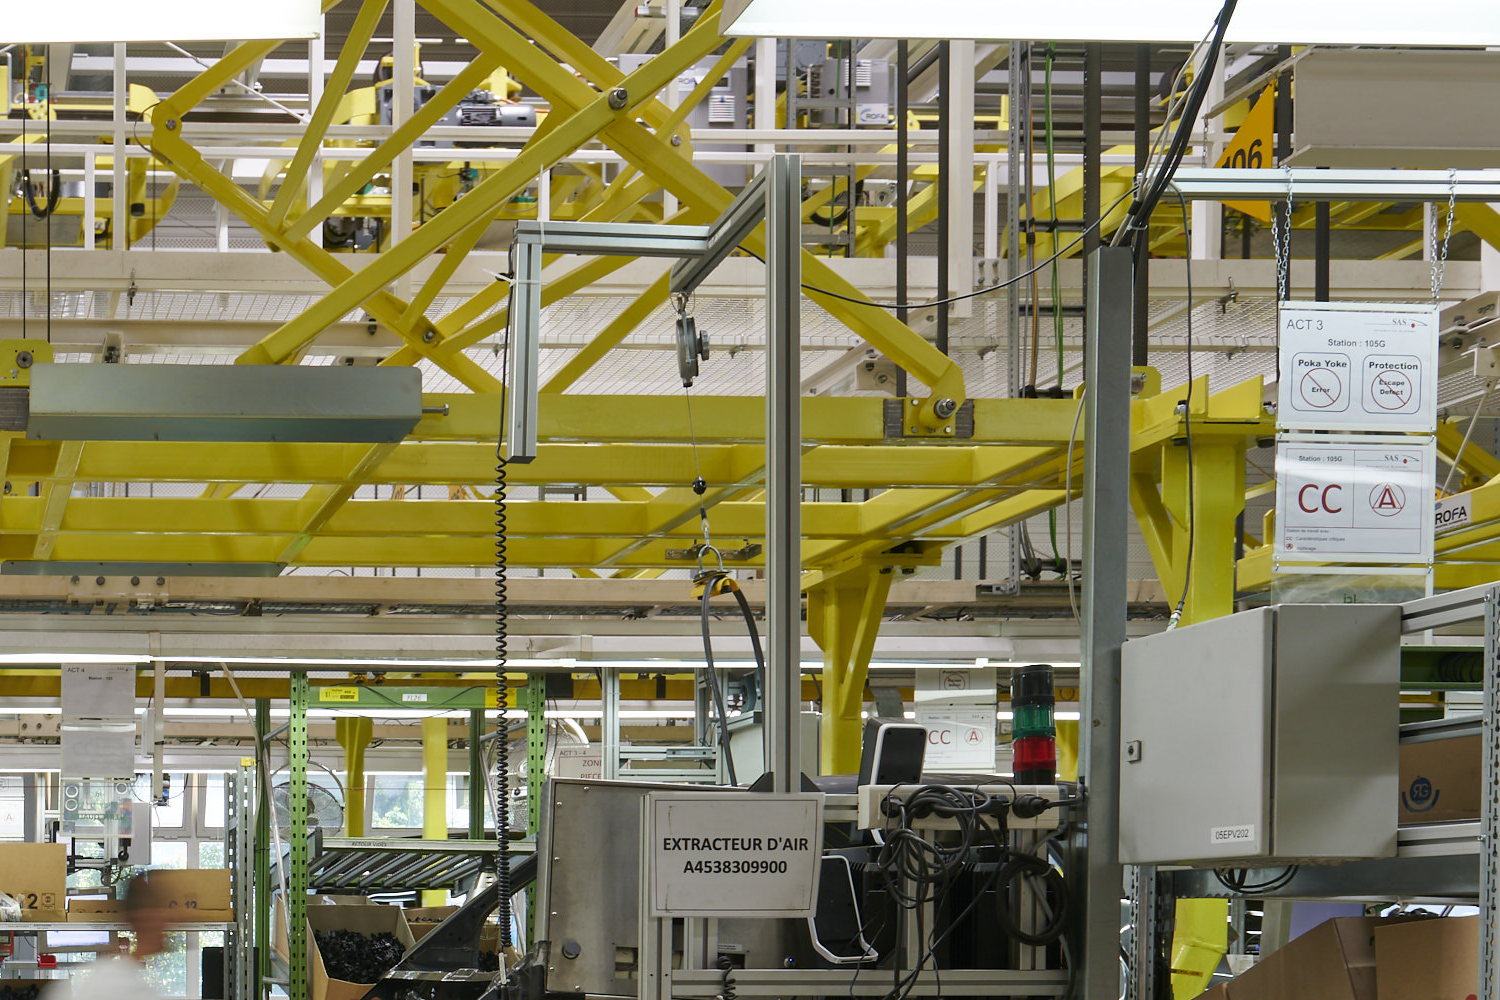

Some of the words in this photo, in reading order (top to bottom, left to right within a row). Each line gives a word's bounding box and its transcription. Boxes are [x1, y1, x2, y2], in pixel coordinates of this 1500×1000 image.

[1286, 319, 1313, 330] ACT
[1316, 319, 1324, 331] 3
[1391, 318, 1407, 326] SAS
[1327, 338, 1357, 347] Station
[1365, 339, 1386, 348] 105G
[1298, 359, 1321, 367] Poka
[1325, 359, 1348, 368] Yoke
[1369, 361, 1419, 370] Protection
[1379, 379, 1405, 387] Escape
[1384, 454, 1399, 462] SAS
[1298, 483, 1343, 514] CC
[1378, 487, 1397, 509] A
[1435, 505, 1467, 525] ROFA
[928, 729, 951, 745] CC
[582, 759, 602, 767] ZON
[1215, 828, 1249, 840] 05EPV202
[663, 837, 763, 851] EXTRACTEUR
[767, 837, 809, 851] D'AIR
[684, 860, 787, 874] A4538309900
